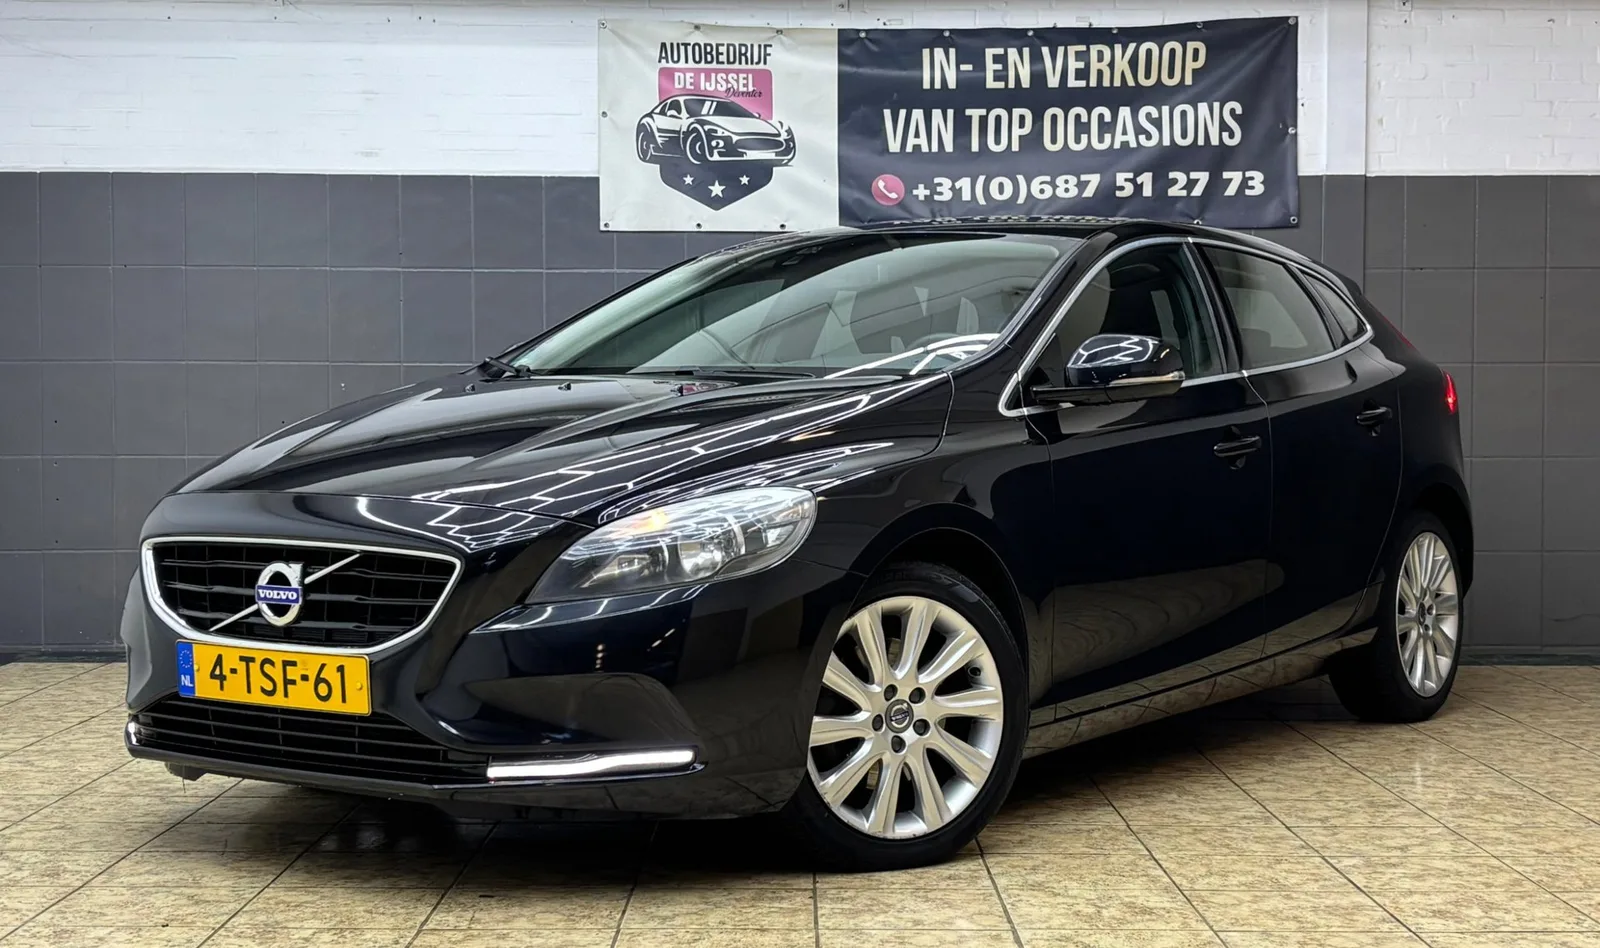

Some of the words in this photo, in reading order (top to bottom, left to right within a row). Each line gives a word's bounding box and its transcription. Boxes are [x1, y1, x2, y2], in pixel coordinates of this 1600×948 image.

[658, 41, 773, 66] AUTOBEDRIJF
[921, 47, 973, 90] IN-
[985, 46, 1031, 89] EN
[1041, 41, 1207, 88] VERKOOP
[674, 72, 695, 90] DE
[700, 73, 756, 92] IJSSEL
[725, 86, 763, 98] Deventer
[883, 108, 954, 153] VAN
[965, 107, 1033, 152] TOP
[1043, 101, 1243, 151] OCCASIONS
[912, 173, 1100, 204] +31(0)687
[1115, 172, 1153, 197] 51
[1168, 171, 1210, 197] 27
[1222, 171, 1265, 196] 73
[258, 589, 298, 600] VOLVO
[181, 675, 194, 687] NL
[209, 653, 347, 704] 4-TSF-61
